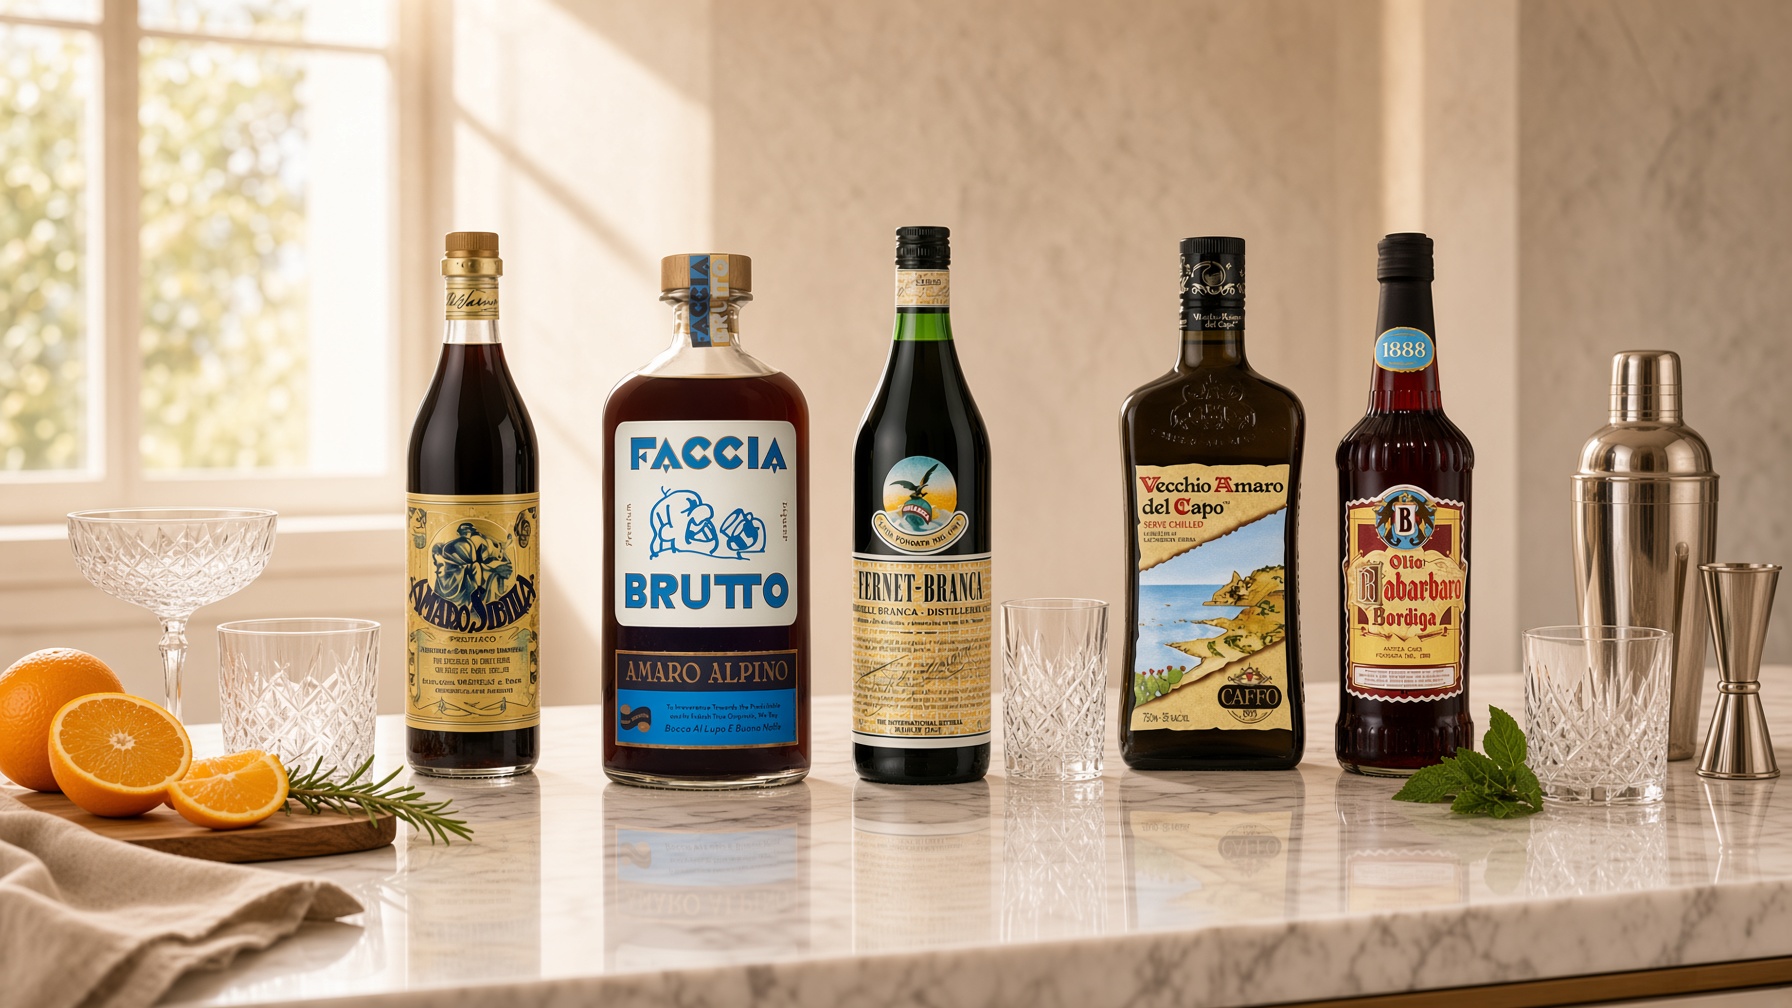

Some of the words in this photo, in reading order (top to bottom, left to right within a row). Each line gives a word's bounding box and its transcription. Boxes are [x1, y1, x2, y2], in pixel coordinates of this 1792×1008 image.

[690, 256, 712, 347] FACCIA
[1383, 342, 1426, 358] 1888
[630, 436, 787, 474] FACCIA
[1139, 476, 1212, 493] Vecchio
[1214, 476, 1284, 493] Amaro
[1142, 498, 1171, 515] del
[1143, 521, 1167, 529] SERVE
[1168, 521, 1204, 529] CHILLED
[1398, 507, 1412, 532] B
[625, 572, 789, 610] BRUTTO
[858, 571, 984, 602] FERNET-BRANCA
[878, 607, 918, 616] BRANCA
[1372, 606, 1436, 632] Bordiga
[625, 660, 701, 684] AMARO
[707, 660, 788, 683] ALPINO
[1221, 689, 1279, 706] CAFFO
